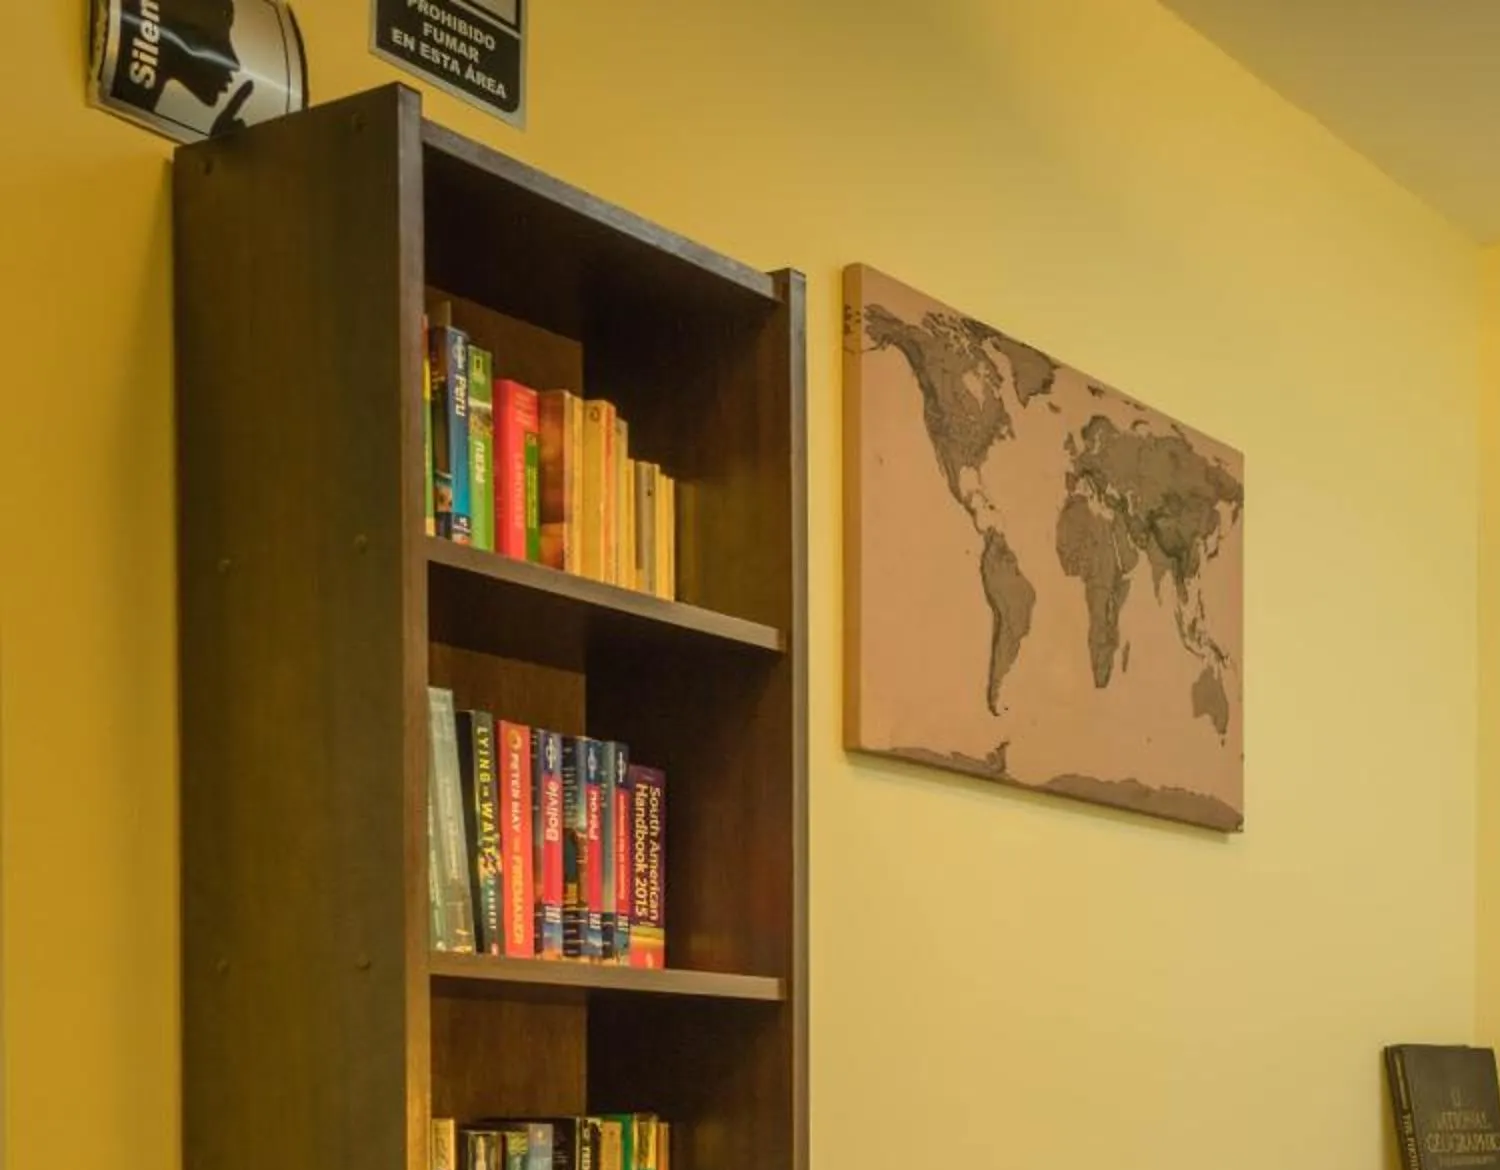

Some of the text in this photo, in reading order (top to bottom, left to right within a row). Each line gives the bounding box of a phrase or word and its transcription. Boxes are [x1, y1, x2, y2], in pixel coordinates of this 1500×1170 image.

[391, 27, 415, 52] EN
[419, 41, 460, 76] ESTA
[422, 22, 479, 64] FUMAR
[477, 726, 493, 781] LYING
[635, 784, 647, 918] Handbook 2015
[649, 787, 660, 920] South American
